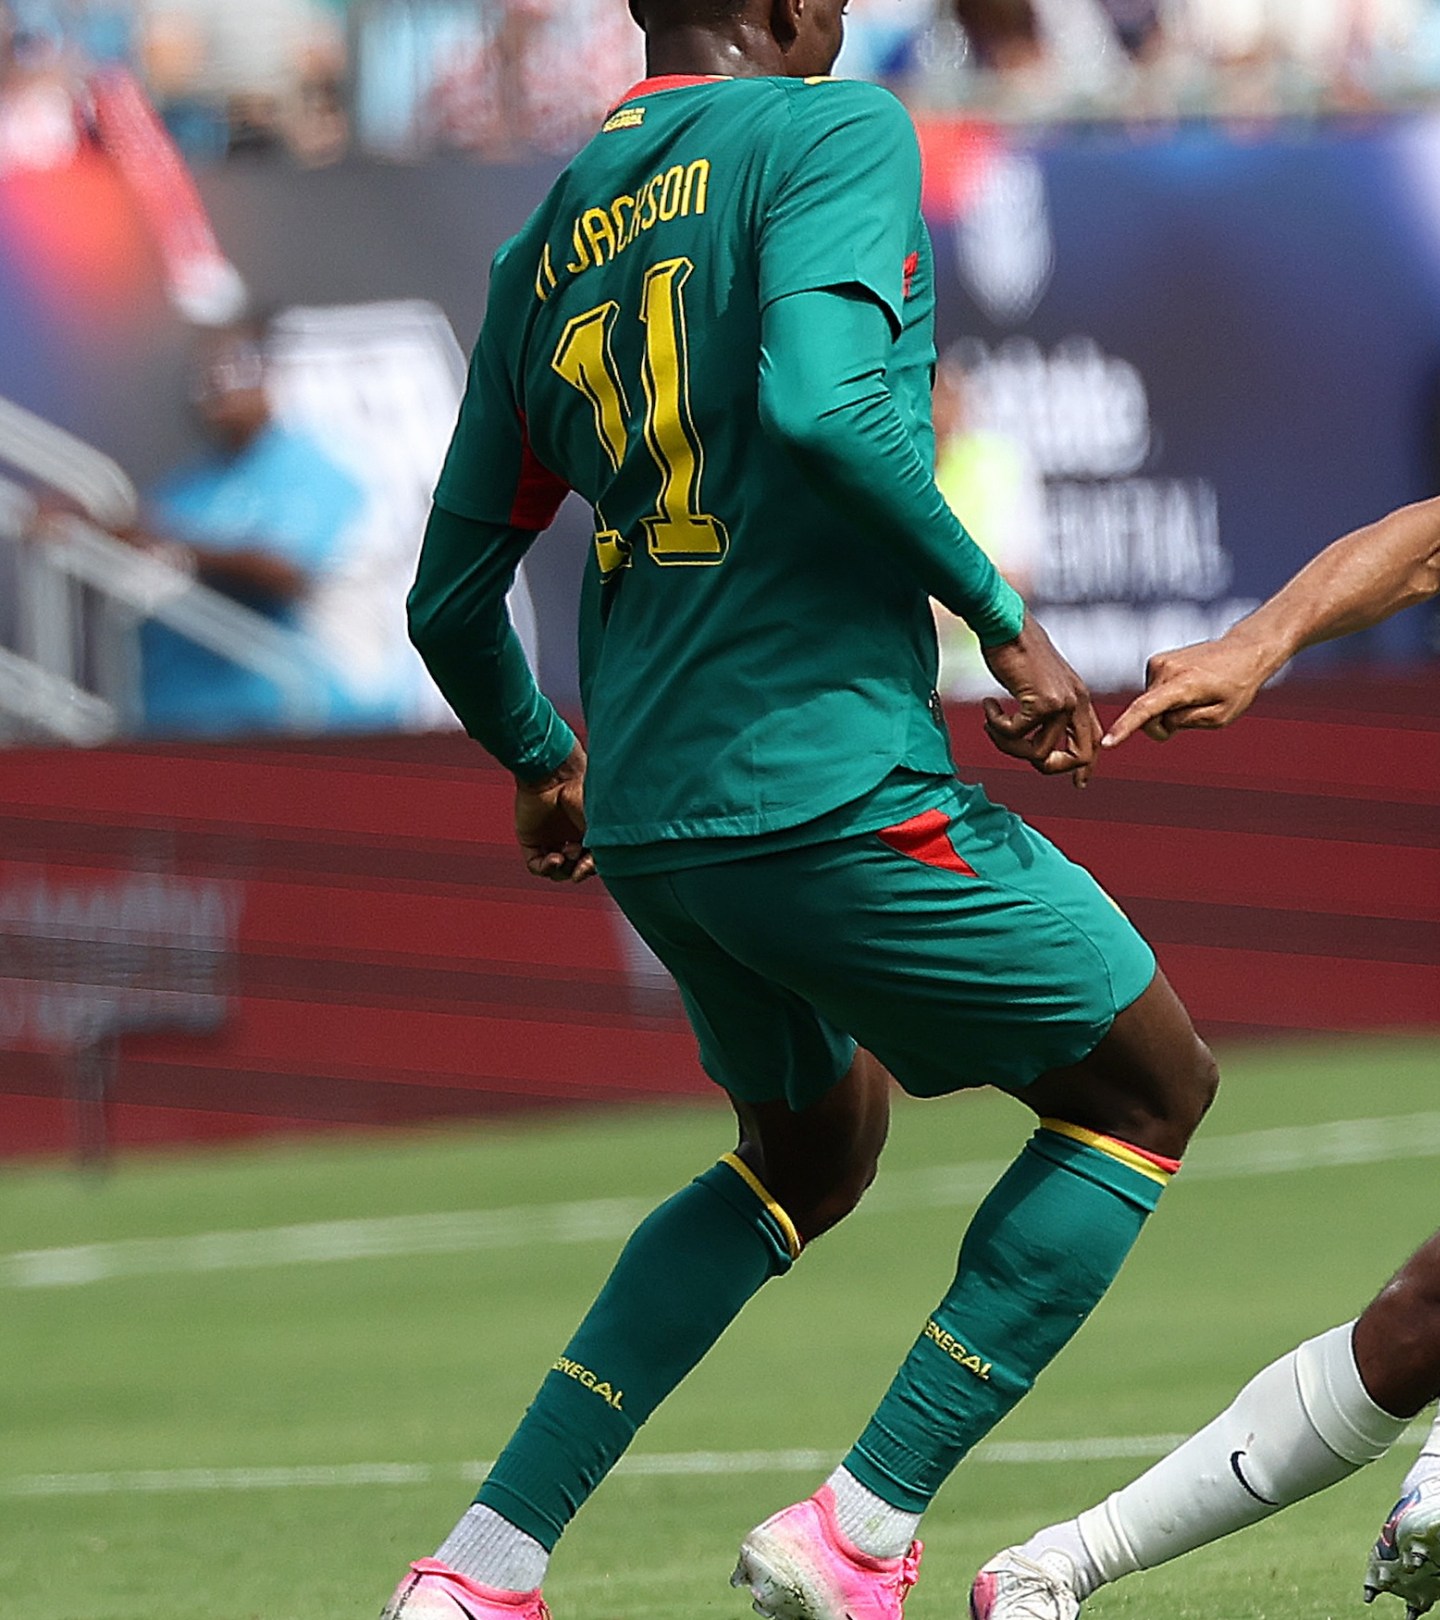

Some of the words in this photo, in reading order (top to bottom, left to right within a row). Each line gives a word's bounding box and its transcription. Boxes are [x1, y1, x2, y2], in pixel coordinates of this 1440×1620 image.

[566, 158, 711, 274] JACKSON
[550, 255, 731, 584] 11
[924, 1321, 993, 1381] ENEGAL
